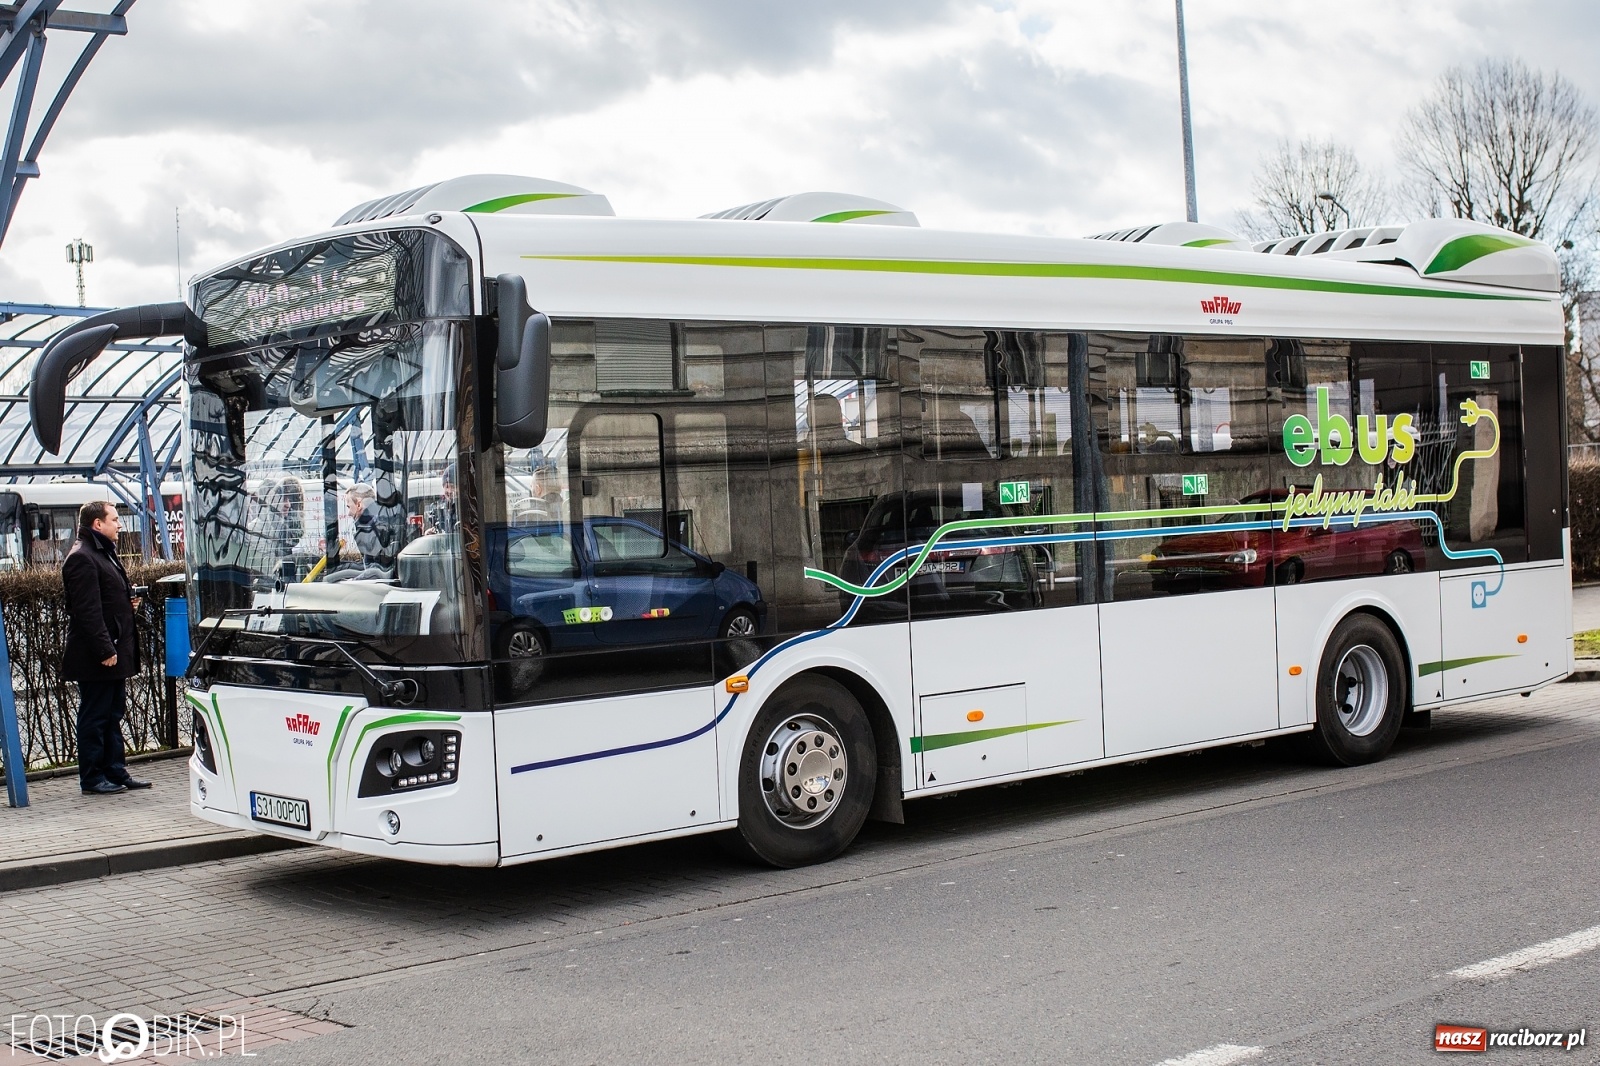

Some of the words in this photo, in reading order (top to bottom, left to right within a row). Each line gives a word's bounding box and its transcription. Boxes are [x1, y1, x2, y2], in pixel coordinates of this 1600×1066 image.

[1200, 296, 1242, 315] RAFAKO
[1283, 386, 1416, 467] ebus
[1282, 473, 1367, 533] jedyny
[1370, 470, 1418, 513] taki
[285, 712, 321, 736] RAFAKO
